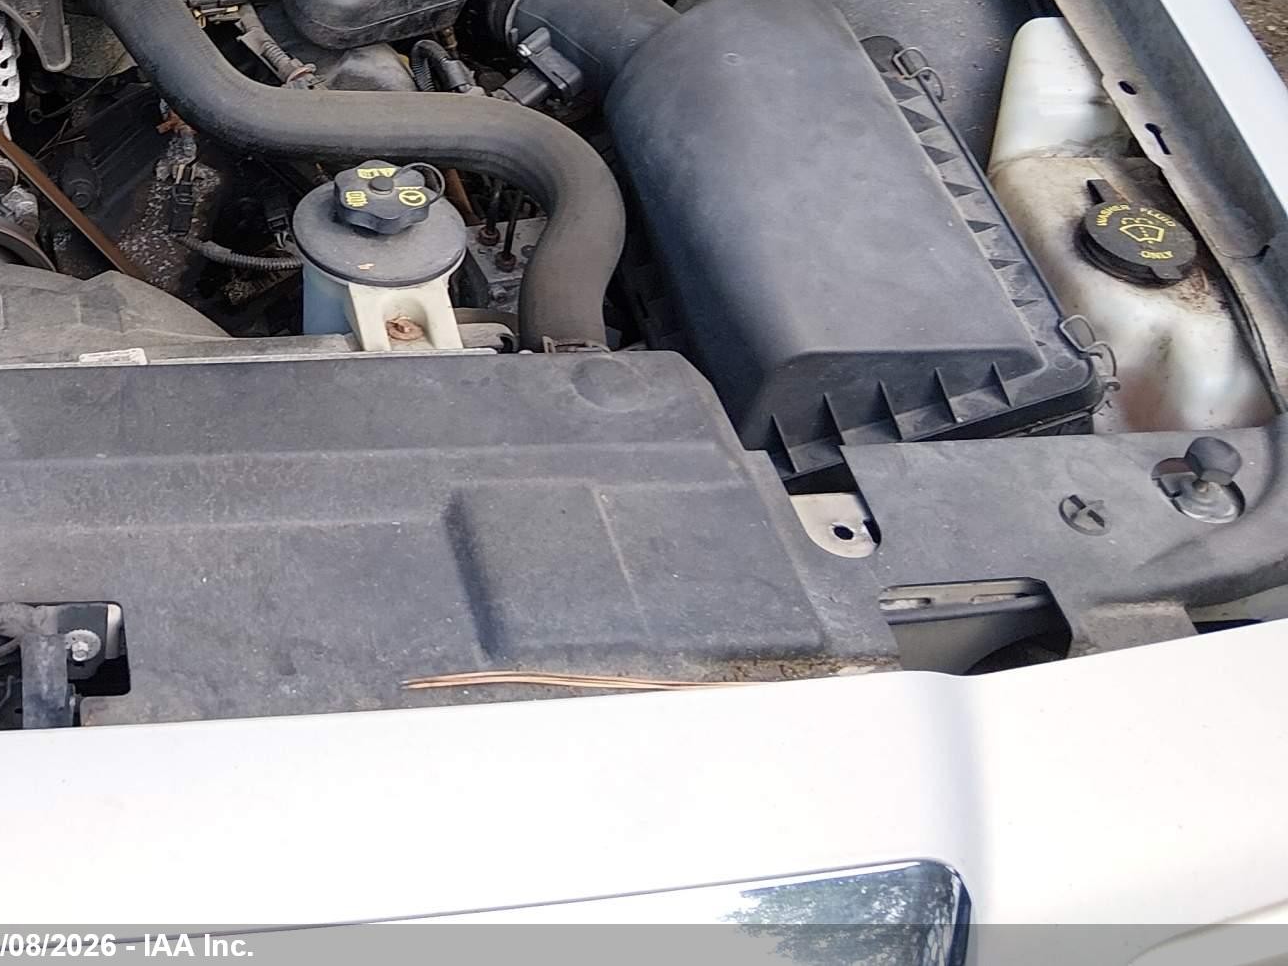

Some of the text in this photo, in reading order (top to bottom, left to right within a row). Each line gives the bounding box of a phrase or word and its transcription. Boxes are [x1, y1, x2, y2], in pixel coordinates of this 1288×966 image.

[1096, 204, 1177, 227] WASHER FLUID
[1140, 250, 1174, 260] ONLY
